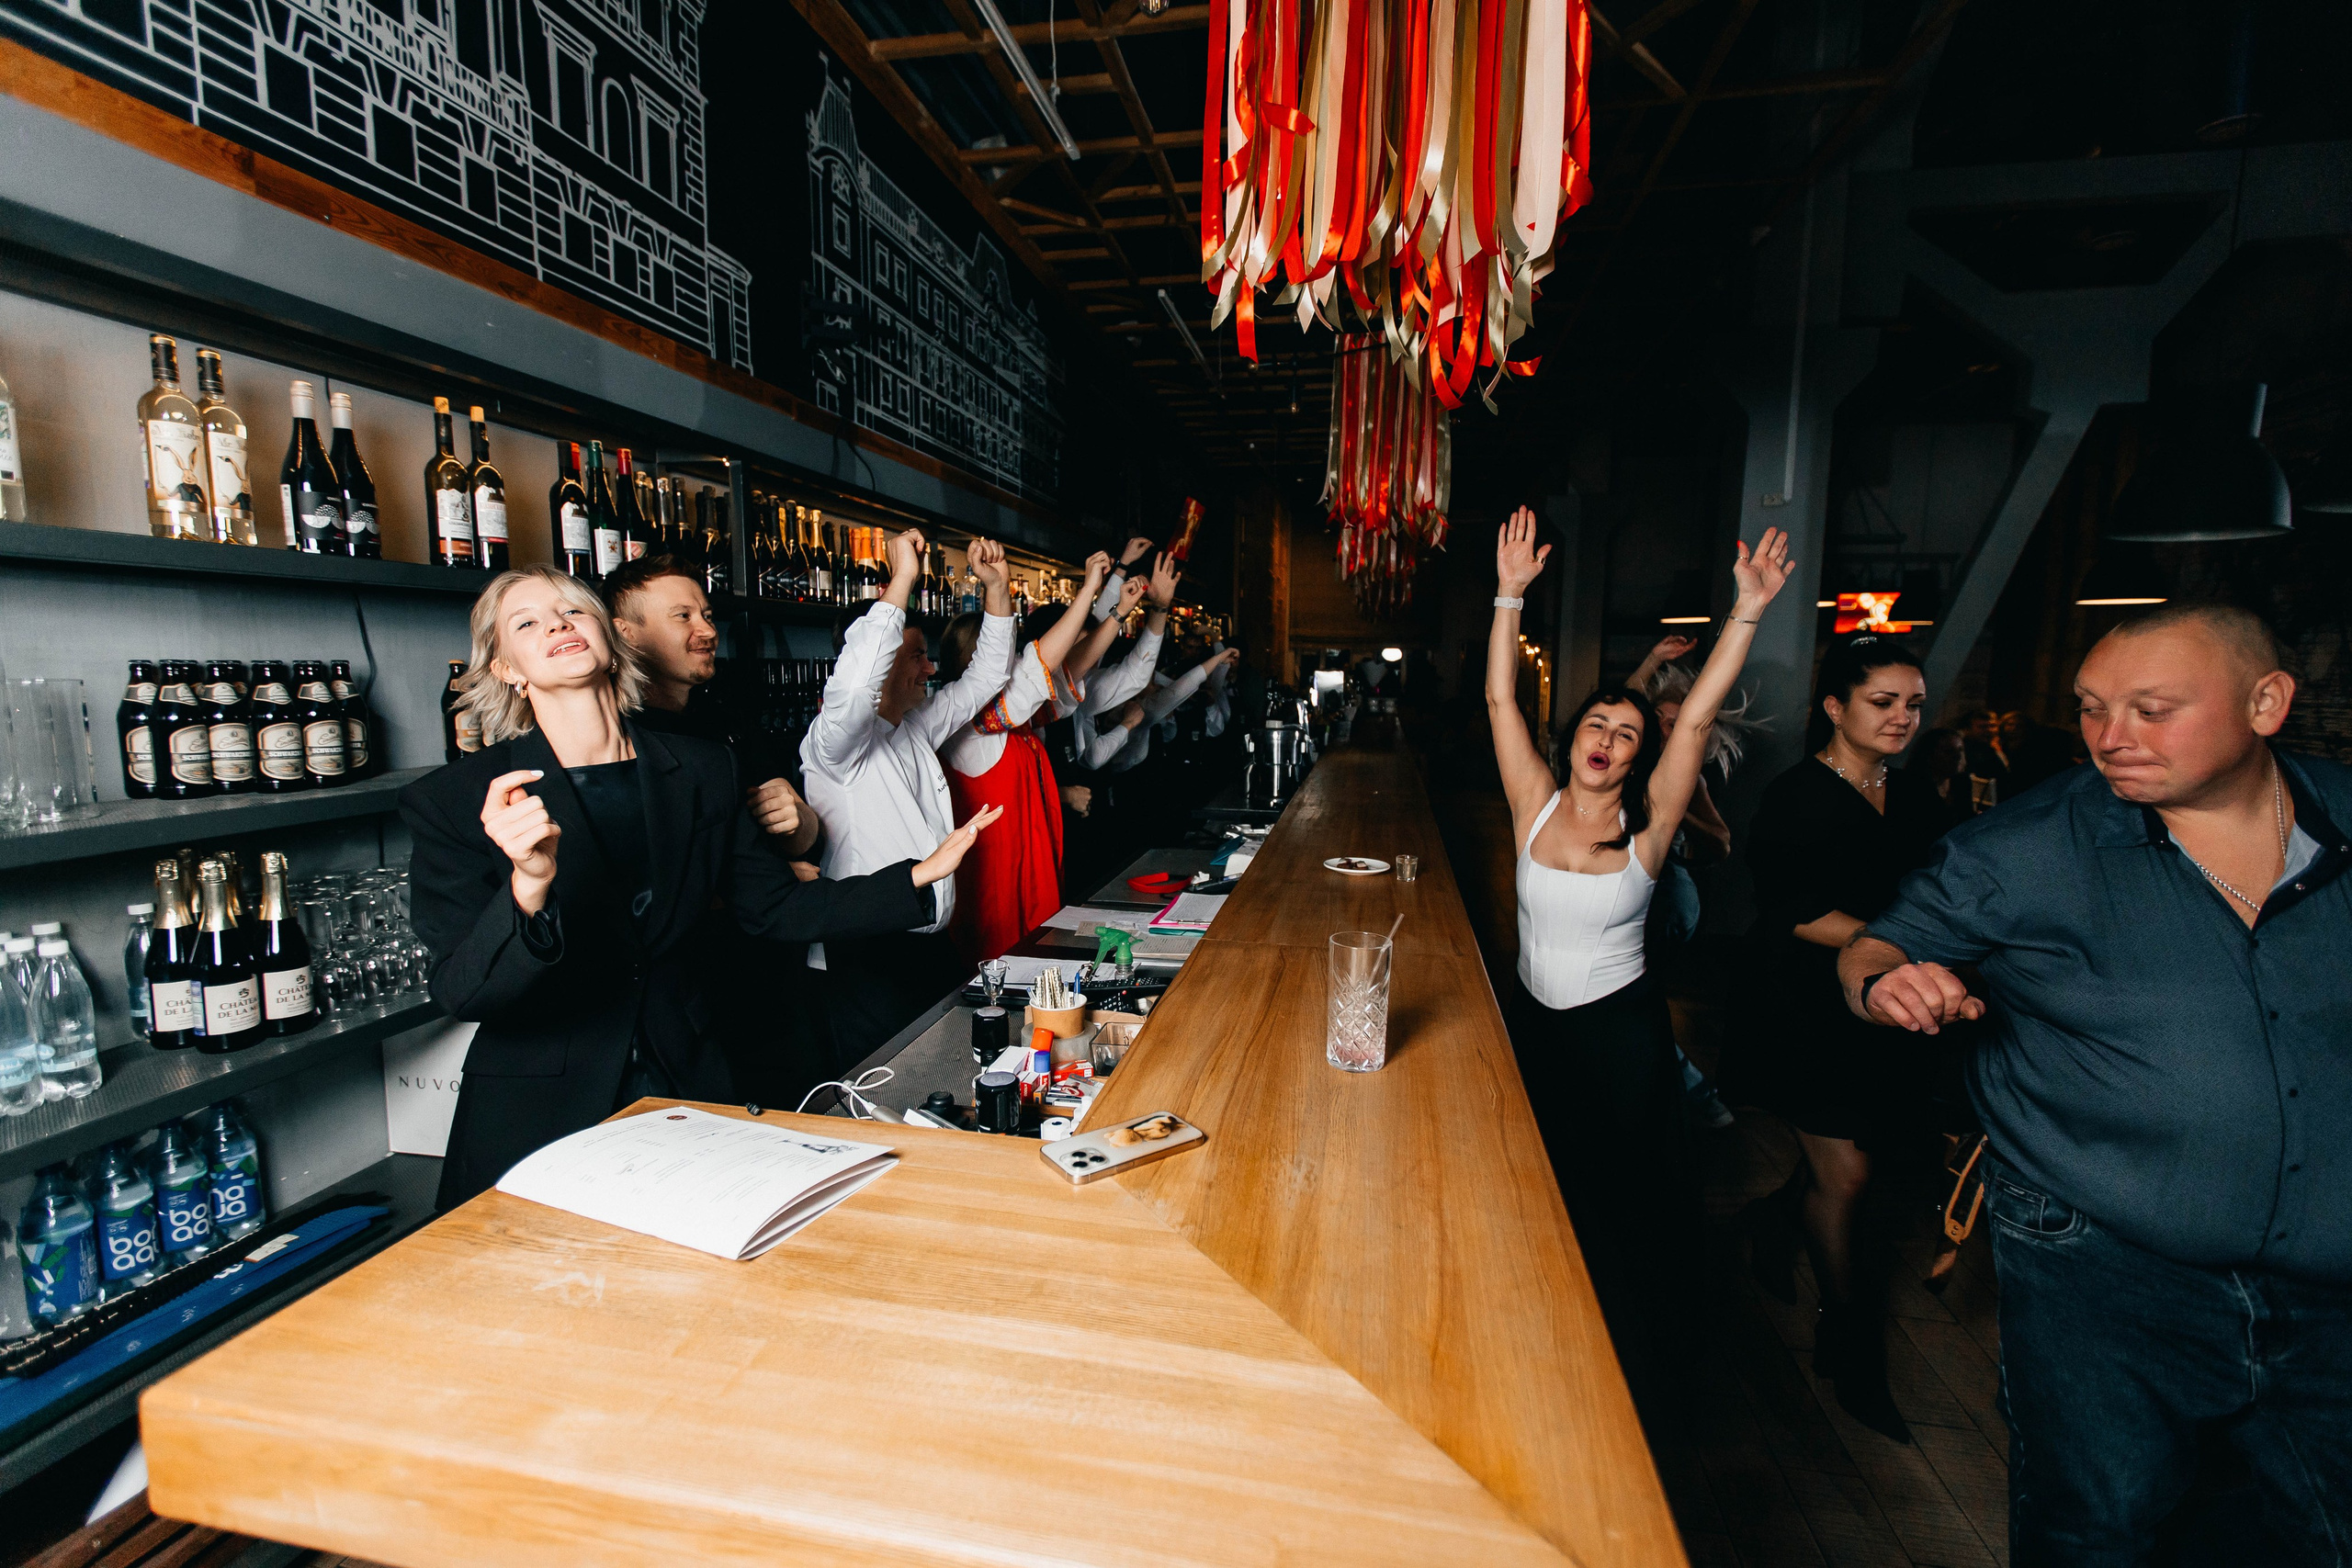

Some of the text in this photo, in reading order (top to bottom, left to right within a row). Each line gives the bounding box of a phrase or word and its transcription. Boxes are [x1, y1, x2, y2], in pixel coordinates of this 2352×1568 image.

[277, 984, 311, 996] CHÂTE
[165, 998, 192, 1009] CHÂ
[220, 997, 257, 1010] CHÂTEA
[277, 993, 304, 1004] DE LA
[164, 1008, 179, 1016] DE
[218, 1010, 232, 1019] DE
[235, 1007, 248, 1016] LA
[169, 1202, 209, 1227] bo
[171, 1218, 210, 1243] aq
